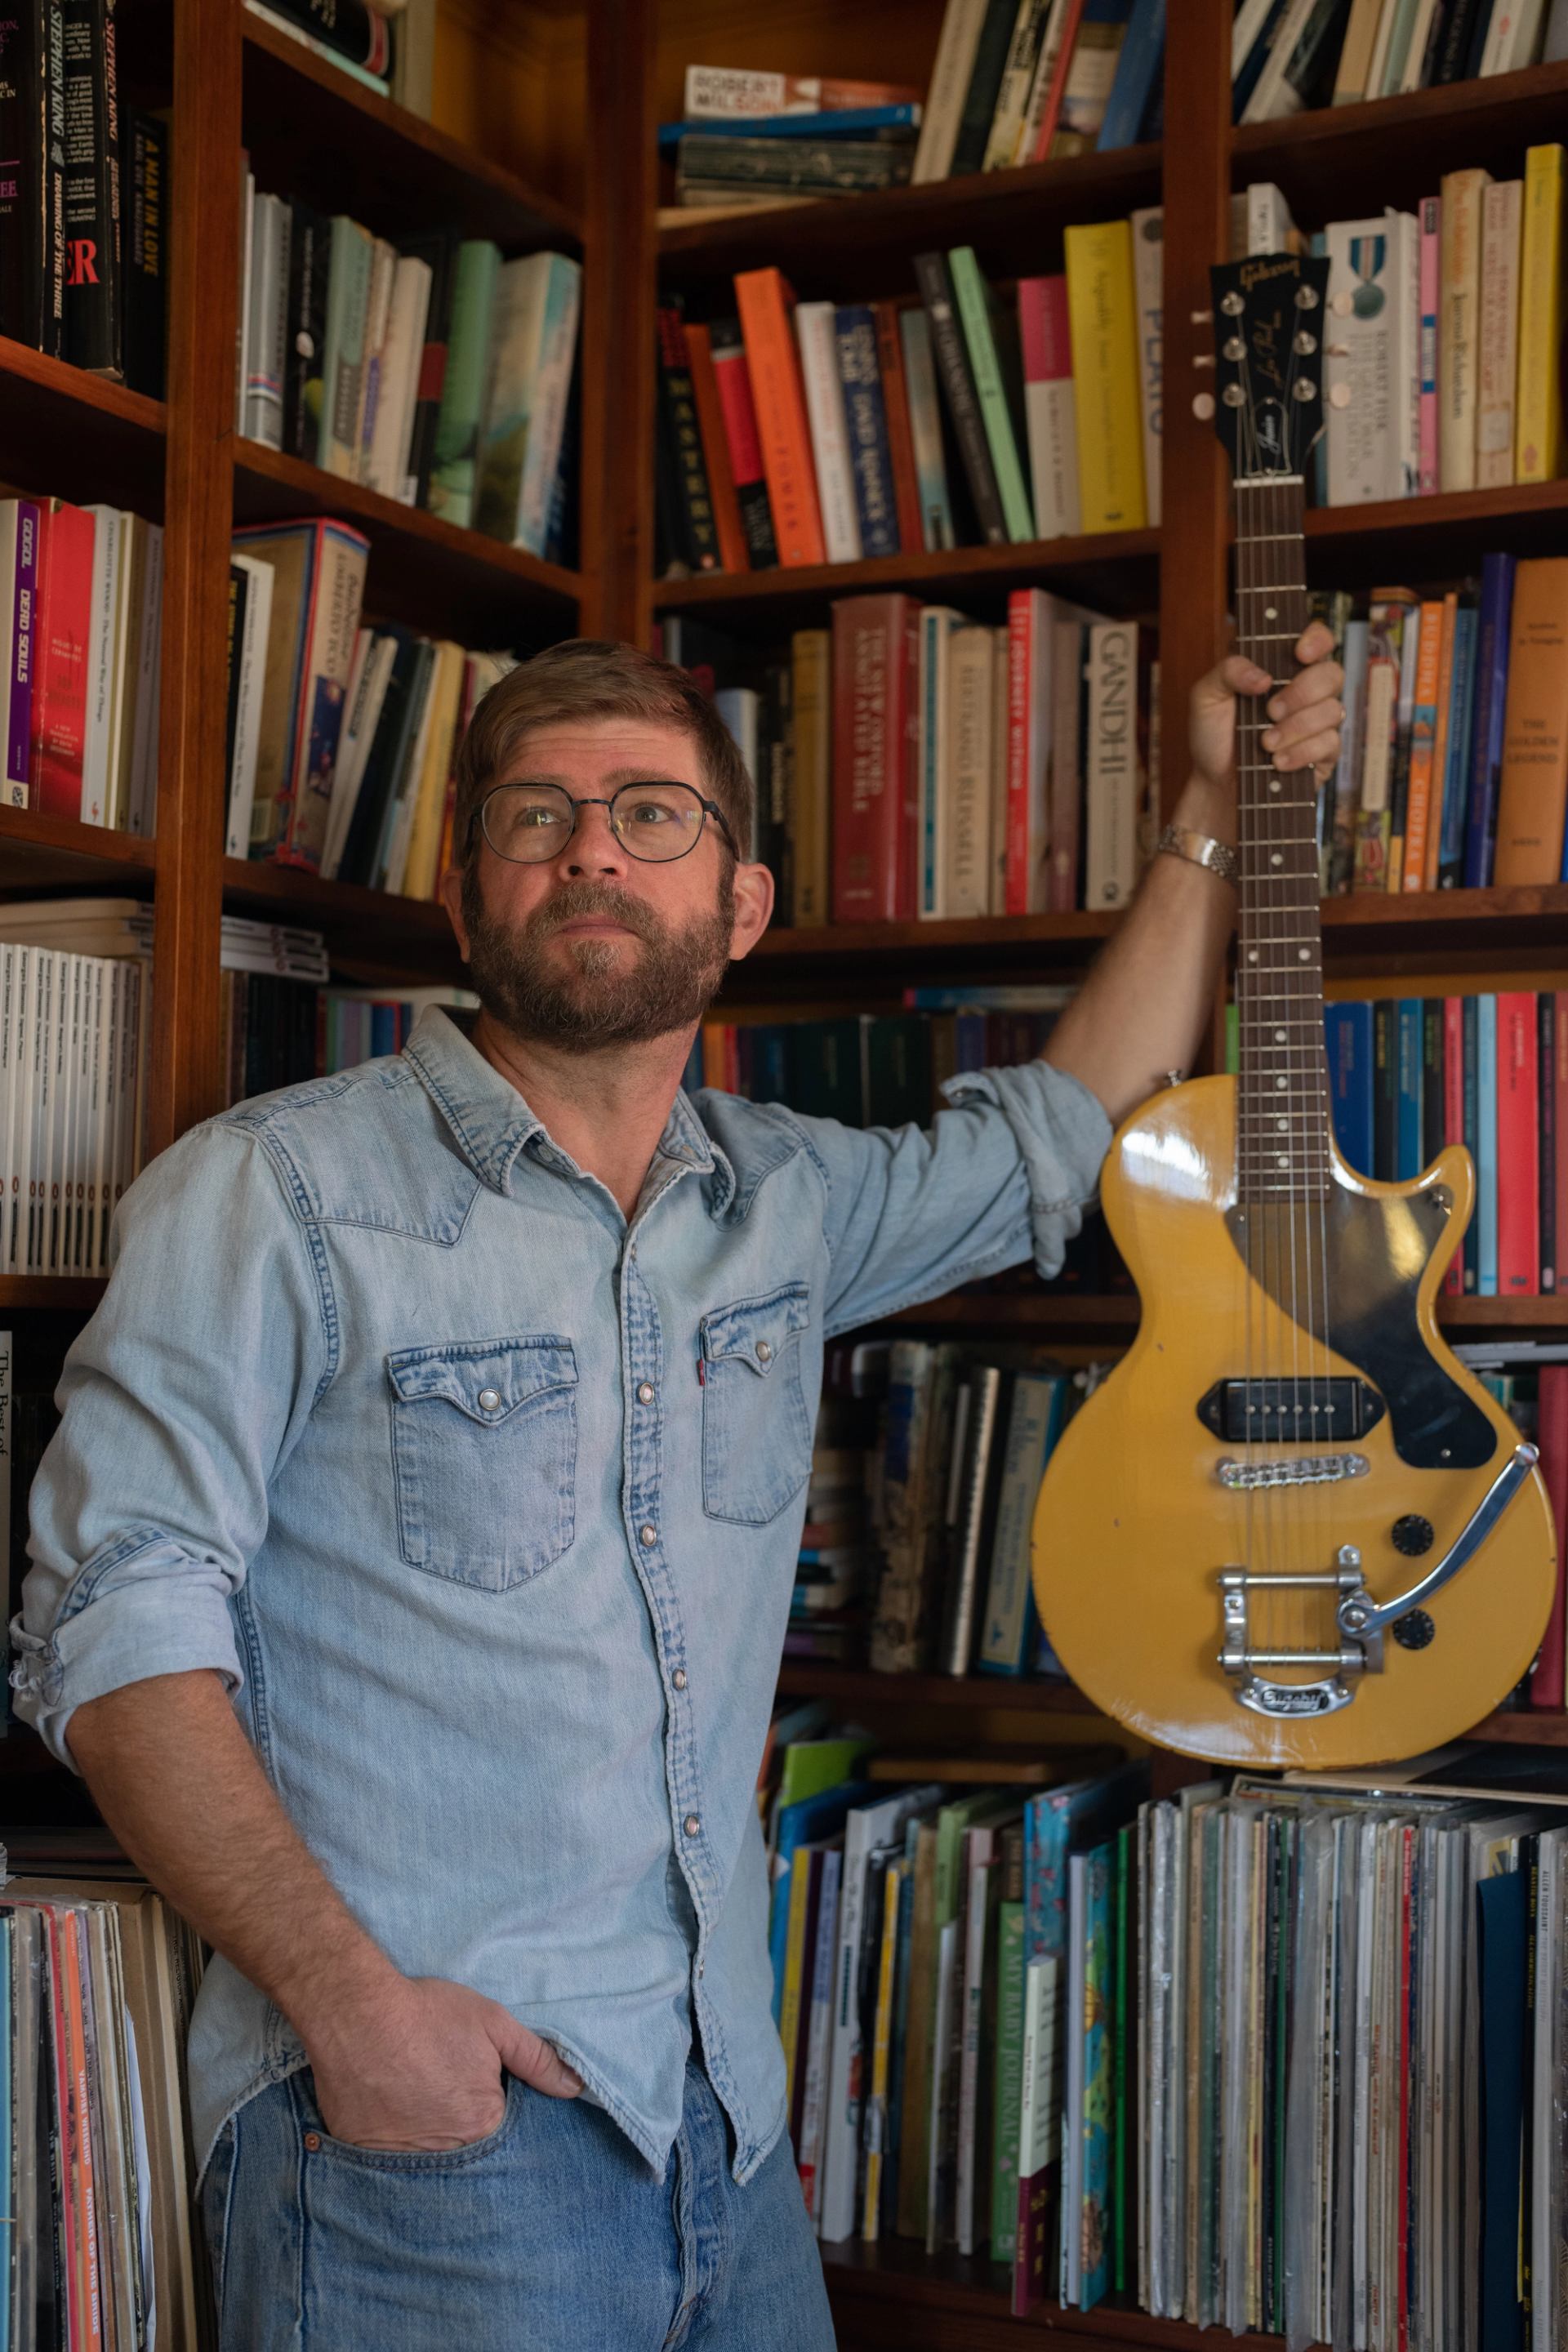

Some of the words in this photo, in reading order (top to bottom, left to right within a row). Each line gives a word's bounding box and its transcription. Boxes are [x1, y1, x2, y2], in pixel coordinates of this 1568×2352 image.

[51, 7, 64, 91] STEPHEN
[105, 17, 117, 96] STEPHEN
[51, 89, 65, 137] KING
[108, 97, 118, 142] KING
[145, 138, 159, 154] A
[54, 172, 63, 229] DRAWING
[145, 158, 159, 203] MAN
[145, 204, 159, 226] IN
[54, 230, 63, 247] OF
[144, 229, 158, 276] LOVE
[54, 251, 63, 275] THE
[54, 277, 63, 319] THREE
[21, 518, 33, 568] GOGOL
[105, 520, 115, 579] CHARLOTTE
[19, 588, 31, 630] DEAD
[329, 552, 348, 634] UMBERTO
[18, 633, 29, 683] SOULS
[1419, 612, 1439, 699] BUDDHA
[1099, 631, 1130, 774] GANDHI
[1522, 718, 1546, 731] THE
[1506, 753, 1558, 765] LEGEND
[956, 775, 975, 878] RUSSELL
[1410, 777, 1427, 862] CHOPRA
[0, 1351, 9, 1388] The
[0, 1393, 8, 1428] Best
[1263, 1690, 1322, 1711] Bigsby
[1541, 1870, 1549, 1892] ALLEN
[174, 1958, 183, 1995] RELIGION
[1008, 1953, 1022, 1987] MY
[1004, 1991, 1022, 2043] BABY
[78, 2069, 88, 2115] VAMPIRE
[1000, 2047, 1020, 2143] JOURNAL
[81, 2116, 91, 2166] WEEKEND
[86, 2186, 95, 2239] FATHER
[88, 2240, 96, 2260] OF
